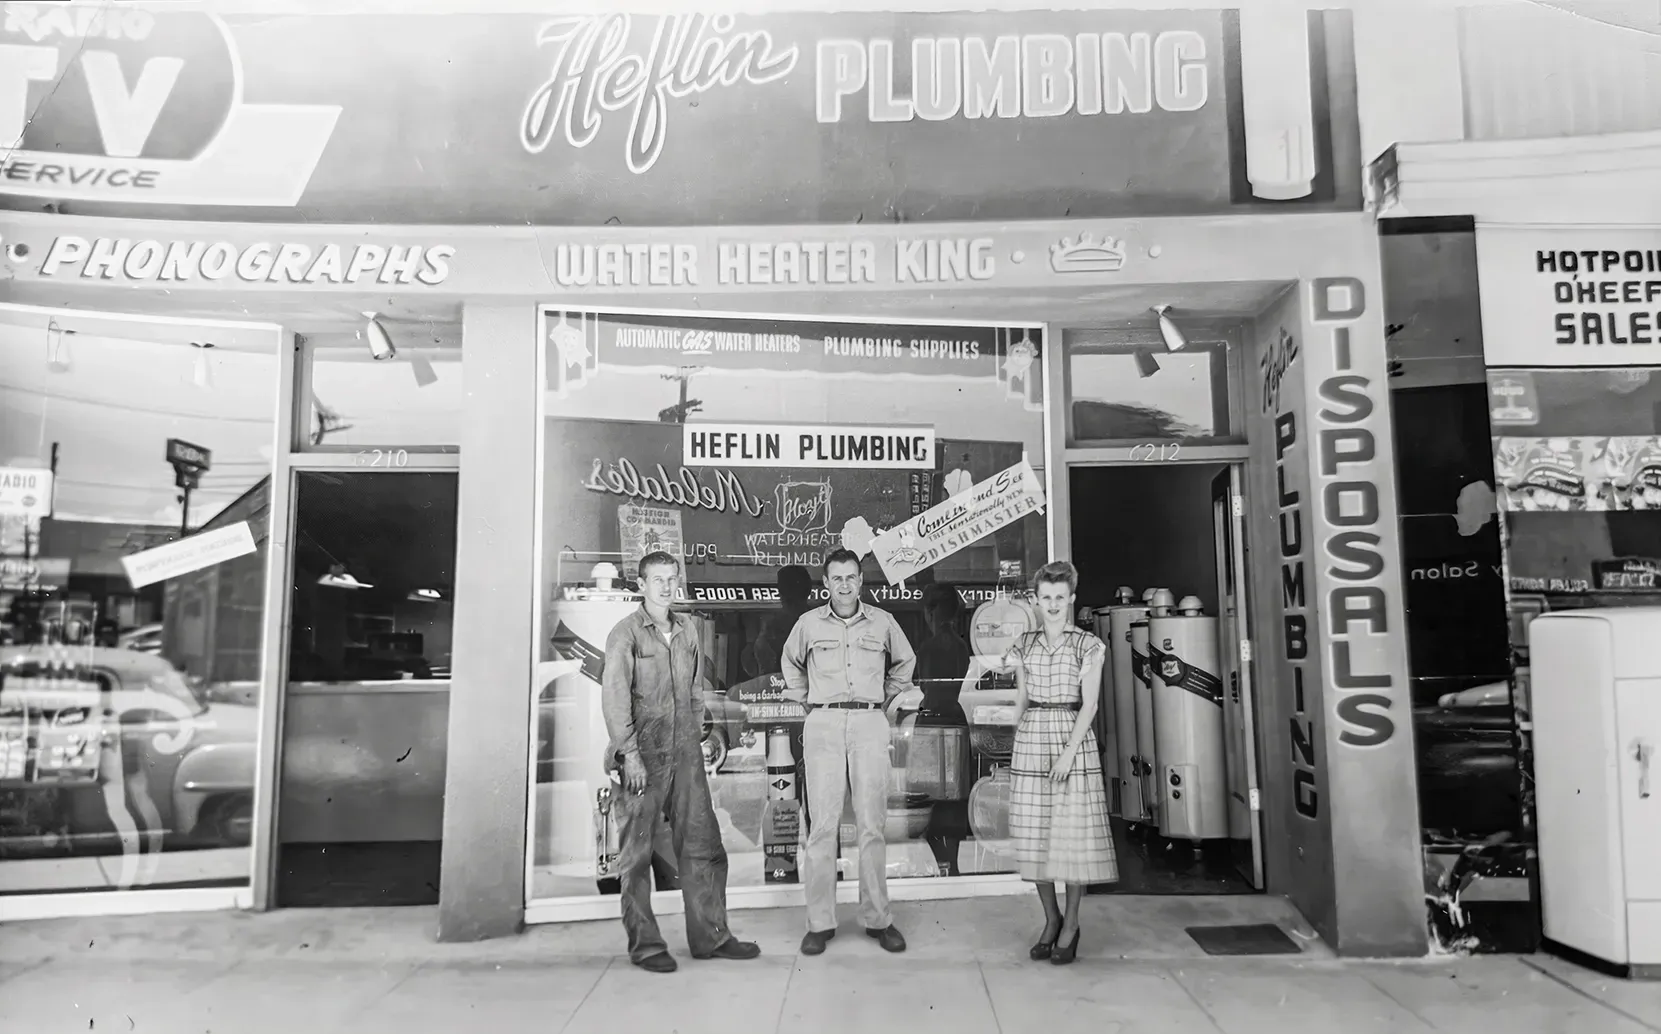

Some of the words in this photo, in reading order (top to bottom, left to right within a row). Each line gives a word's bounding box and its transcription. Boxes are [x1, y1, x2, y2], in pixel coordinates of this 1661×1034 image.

[5, 5, 156, 41] RADIO
[0, 44, 184, 158] TV
[519, 12, 798, 174] Heflin
[816, 30, 1209, 122] PLUMBING
[0, 161, 160, 189] ERVICE
[40, 236, 456, 284] PHONOGRAPHS
[555, 243, 698, 286] WATER
[718, 239, 877, 284] HEATER
[896, 237, 996, 282] KING
[1554, 273, 1661, 303] O'KEEF
[615, 328, 681, 349] AUTOMATIC
[682, 329, 714, 351] GAS
[715, 332, 750, 352] WATER
[755, 334, 800, 353] HEATERS
[1555, 312, 1661, 345] SALE
[824, 336, 902, 358] PLUMBING
[910, 339, 979, 360] SUPPLIES
[691, 432, 780, 459] HEFLIN
[799, 434, 927, 462] PLUMBING
[0, 474, 37, 489] ADIO
[972, 488, 994, 502] nd
[996, 471, 1024, 493] See
[1309, 276, 1395, 747] DISPOSALS
[800, 533, 843, 546] HEAT
[930, 496, 1037, 560] DISHMASTER
[753, 551, 826, 567] PLUMBI
[1275, 411, 1318, 820] PLUMBING
[739, 689, 756, 702] being
[762, 689, 786, 702] Garbag
[770, 675, 786, 689] Stop
